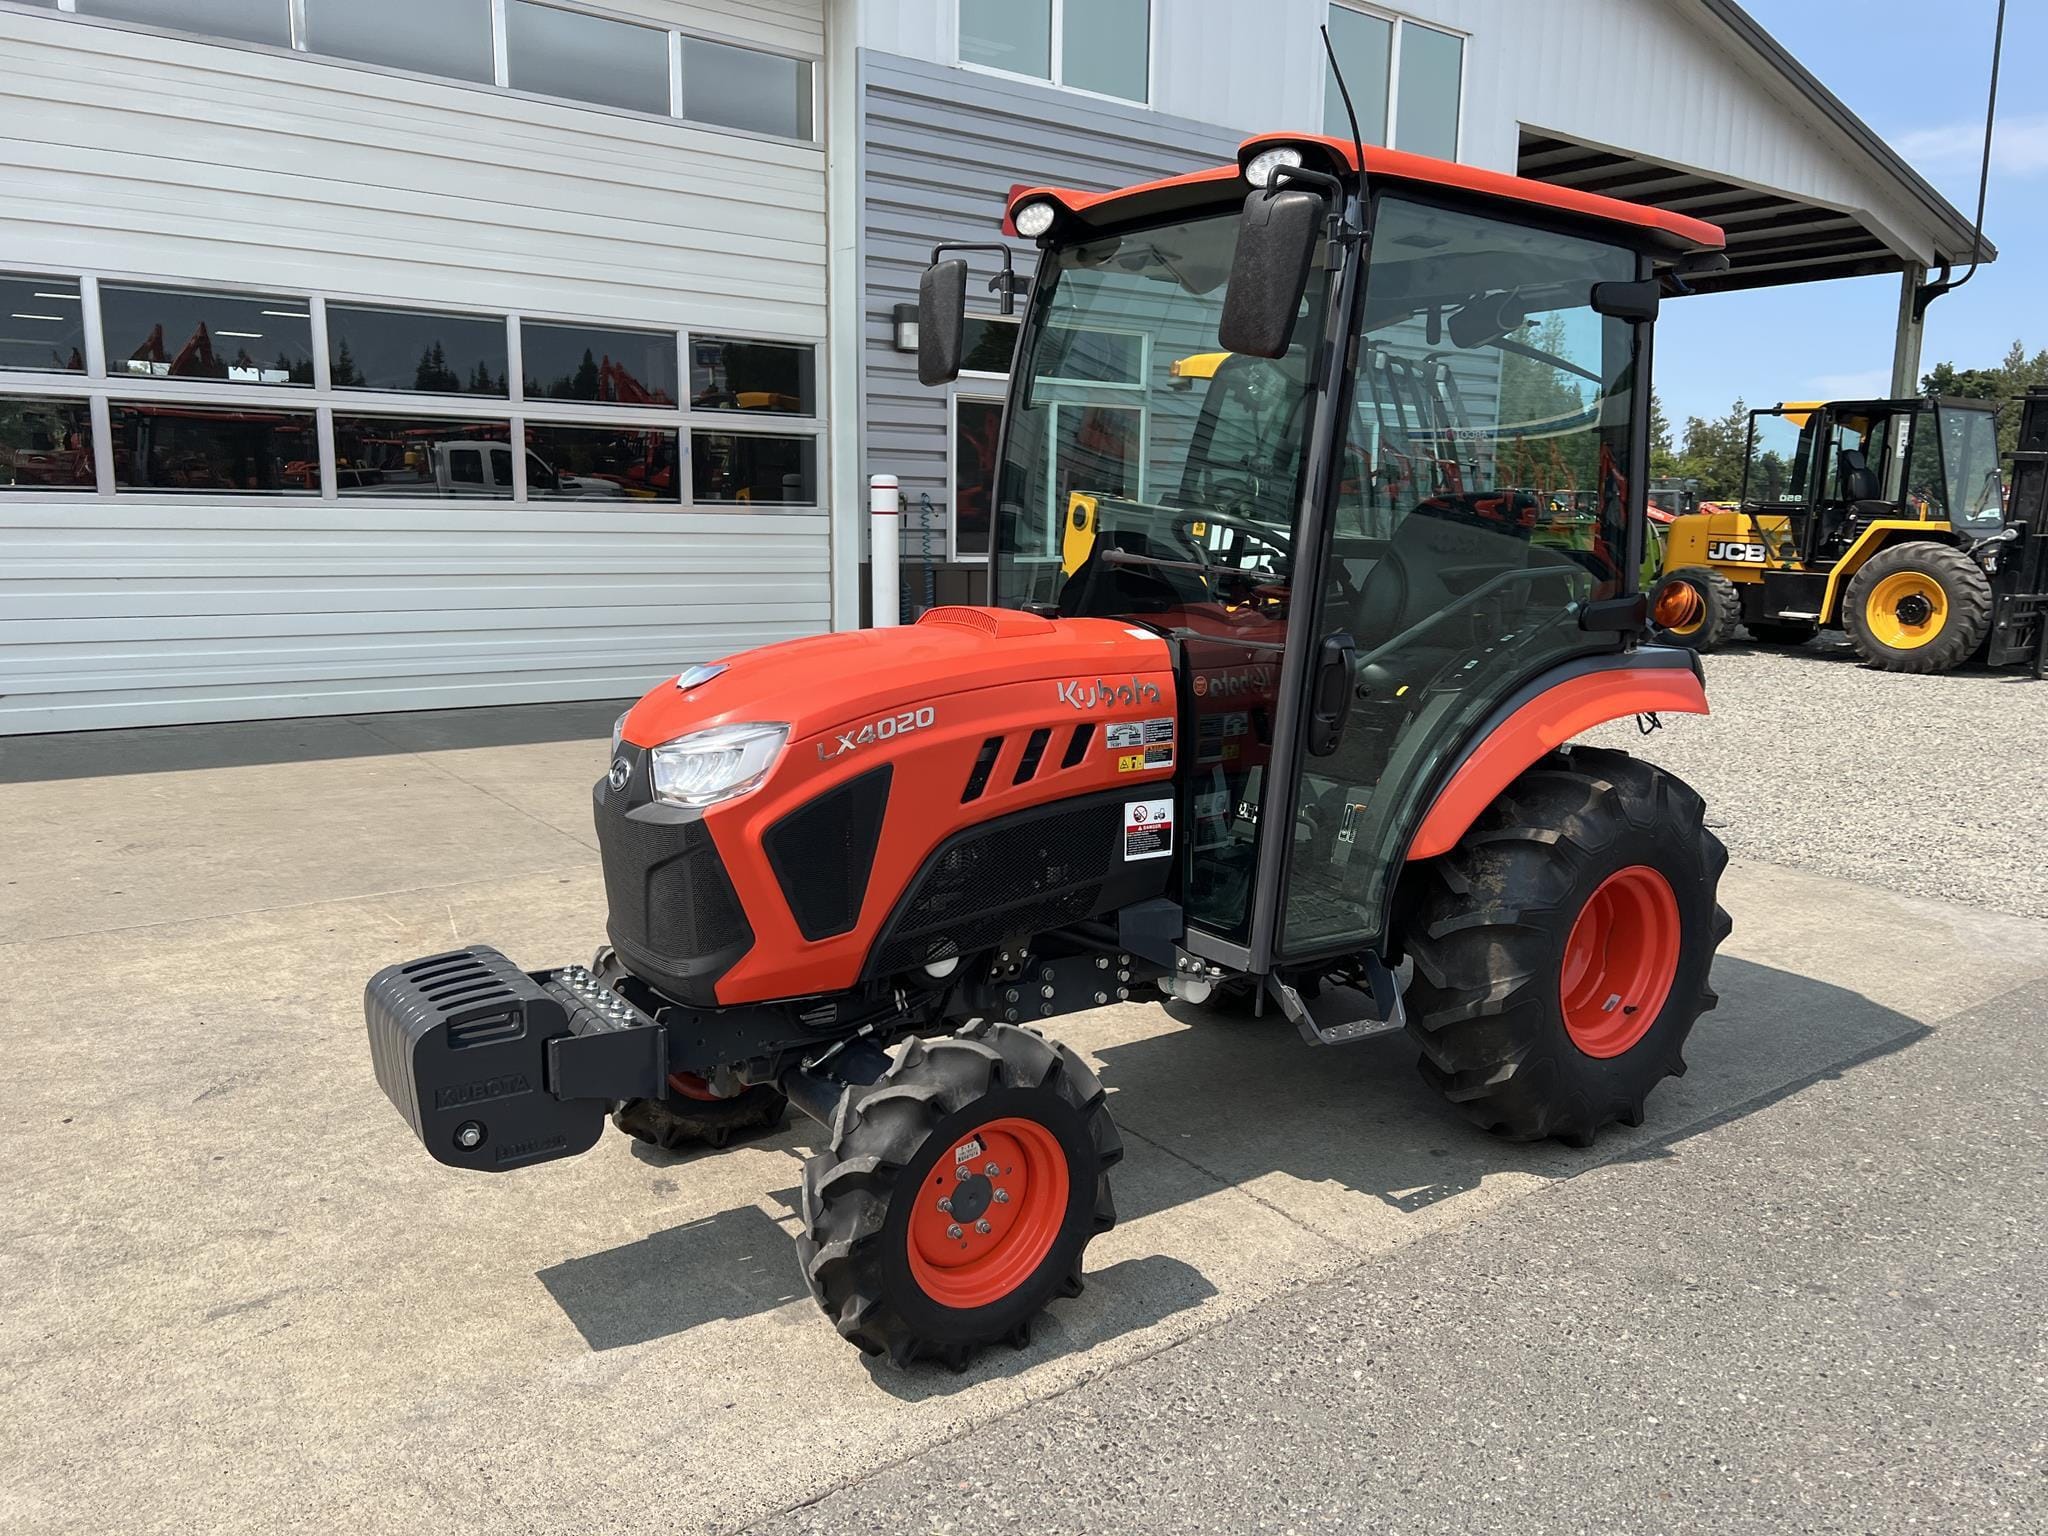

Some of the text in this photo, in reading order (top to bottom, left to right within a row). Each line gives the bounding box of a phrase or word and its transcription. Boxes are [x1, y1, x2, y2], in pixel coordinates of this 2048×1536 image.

[1708, 542, 1766, 563] JCB
[1985, 557, 1998, 572] JC
[1056, 677, 1161, 710] Kubota
[816, 706, 936, 762] LX4020
[440, 1074, 531, 1107] KUBOTA
